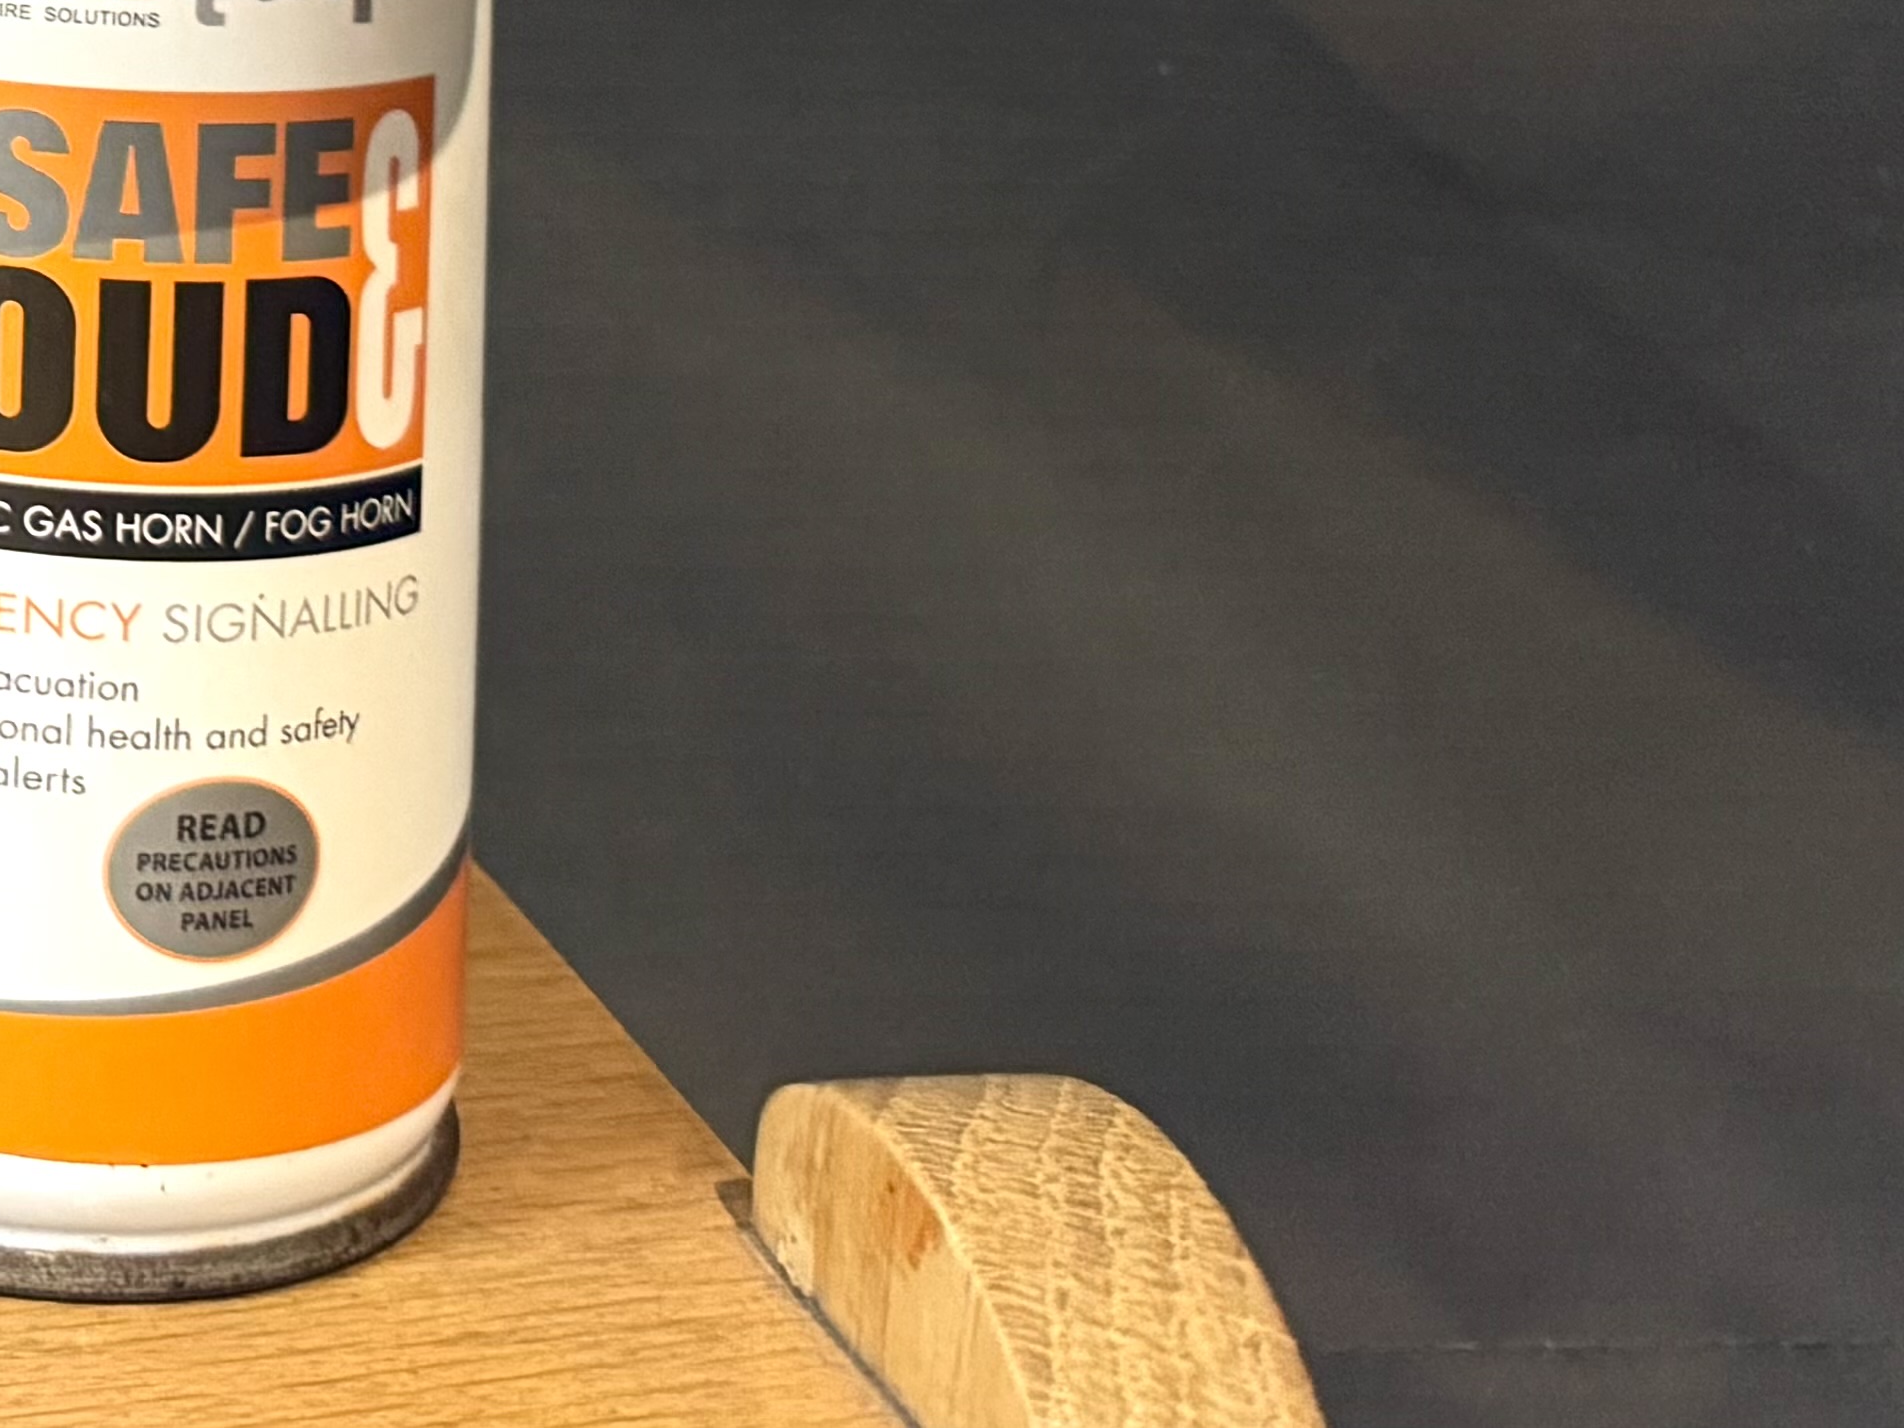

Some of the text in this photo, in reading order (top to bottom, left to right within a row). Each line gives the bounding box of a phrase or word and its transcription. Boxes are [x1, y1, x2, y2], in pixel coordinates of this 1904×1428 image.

[43, 5, 162, 29] SOLUTIONS
[23, 505, 103, 544] GAS
[116, 511, 224, 547] HORN
[234, 511, 253, 549] /
[264, 507, 331, 542] FOG
[340, 488, 414, 535] HORN
[162, 573, 421, 644] SIGNALLING
[87, 714, 192, 750] health
[205, 713, 269, 750] and
[280, 706, 360, 744] safety
[176, 810, 267, 843] READ
[136, 844, 298, 872] PRECAUTIONS
[135, 874, 297, 902] ON ADJACENT
[180, 909, 254, 932] PANEL
